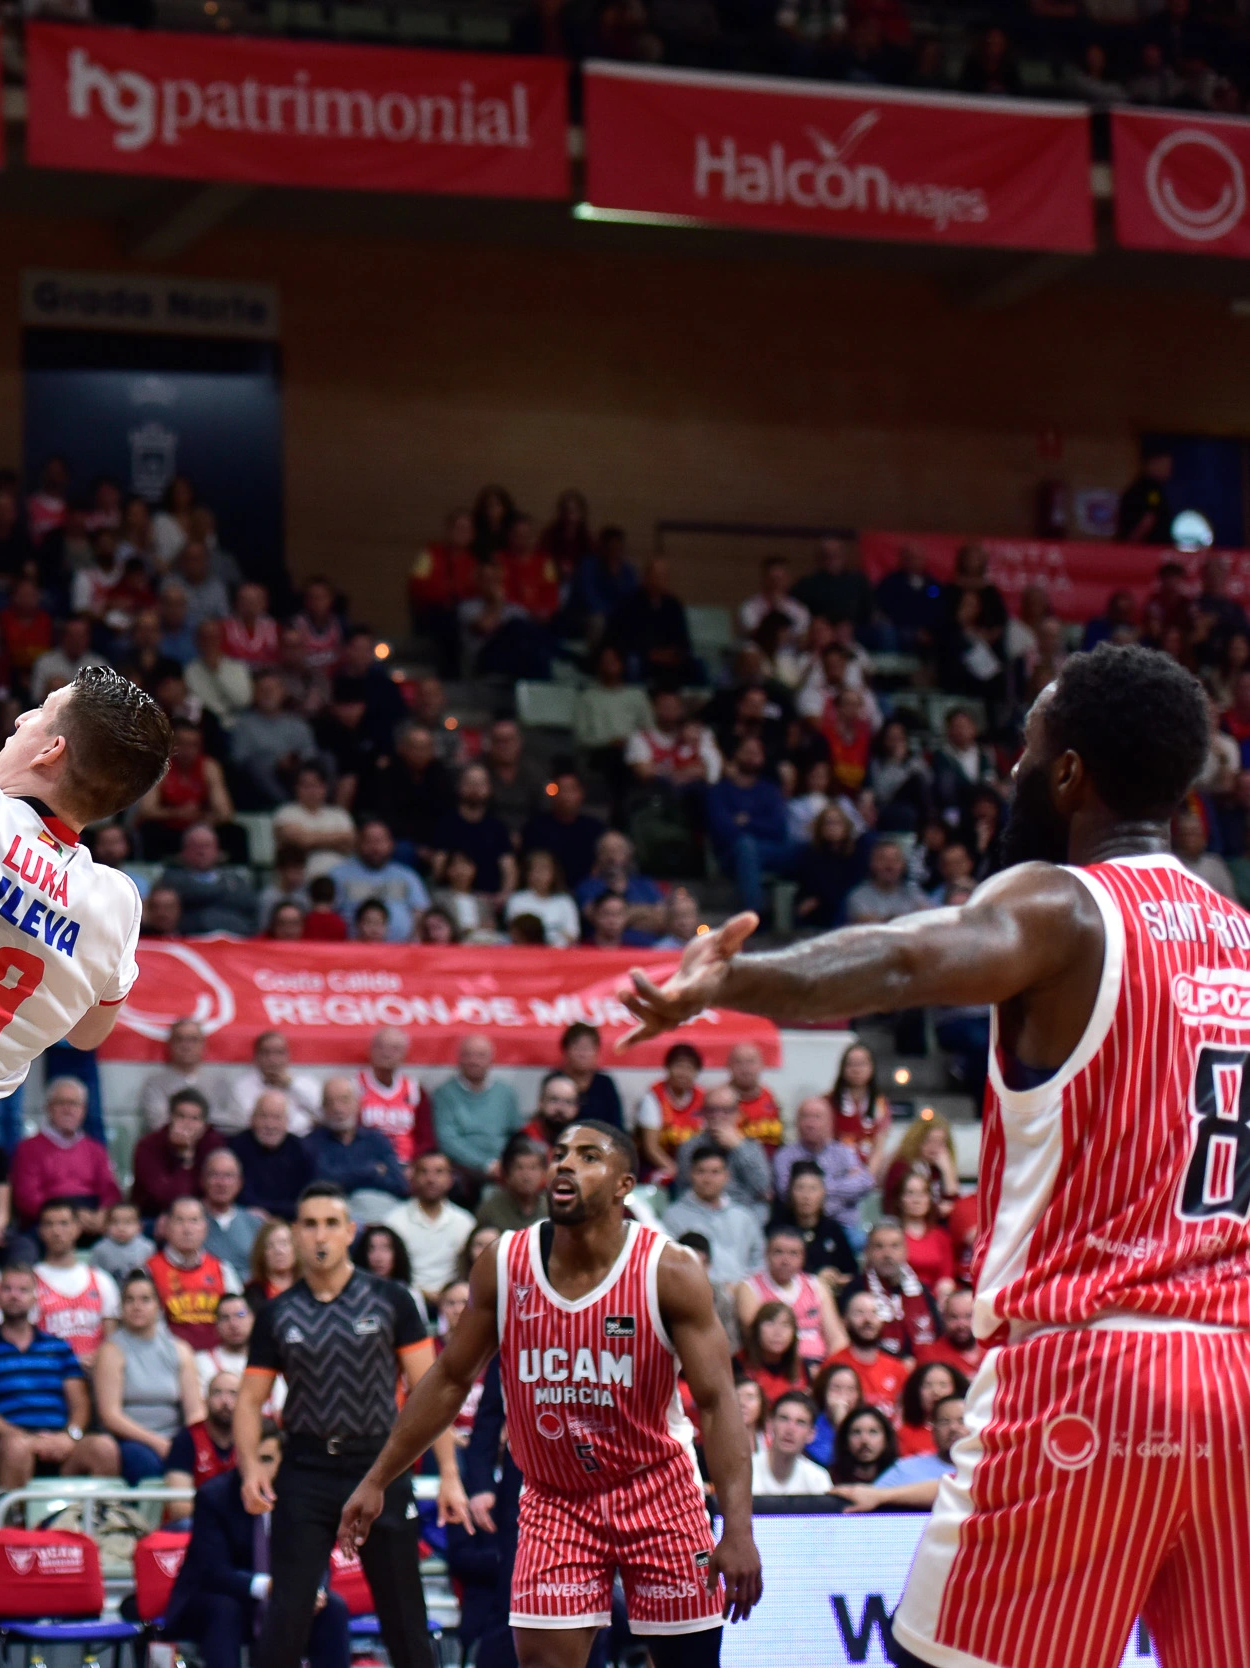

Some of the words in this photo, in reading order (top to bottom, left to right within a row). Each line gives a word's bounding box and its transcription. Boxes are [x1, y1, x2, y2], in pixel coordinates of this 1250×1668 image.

[3, 835, 68, 907] LUKA
[1138, 899, 1250, 950] SANT-RO
[455, 997, 525, 1027] DE
[530, 994, 720, 1027] MUR
[1175, 1042, 1250, 1222] 8
[519, 1348, 633, 1388] UCAM
[534, 1386, 615, 1408] MURCIA
[576, 1444, 600, 1473] 5
[537, 1580, 600, 1597] INVERSUS
